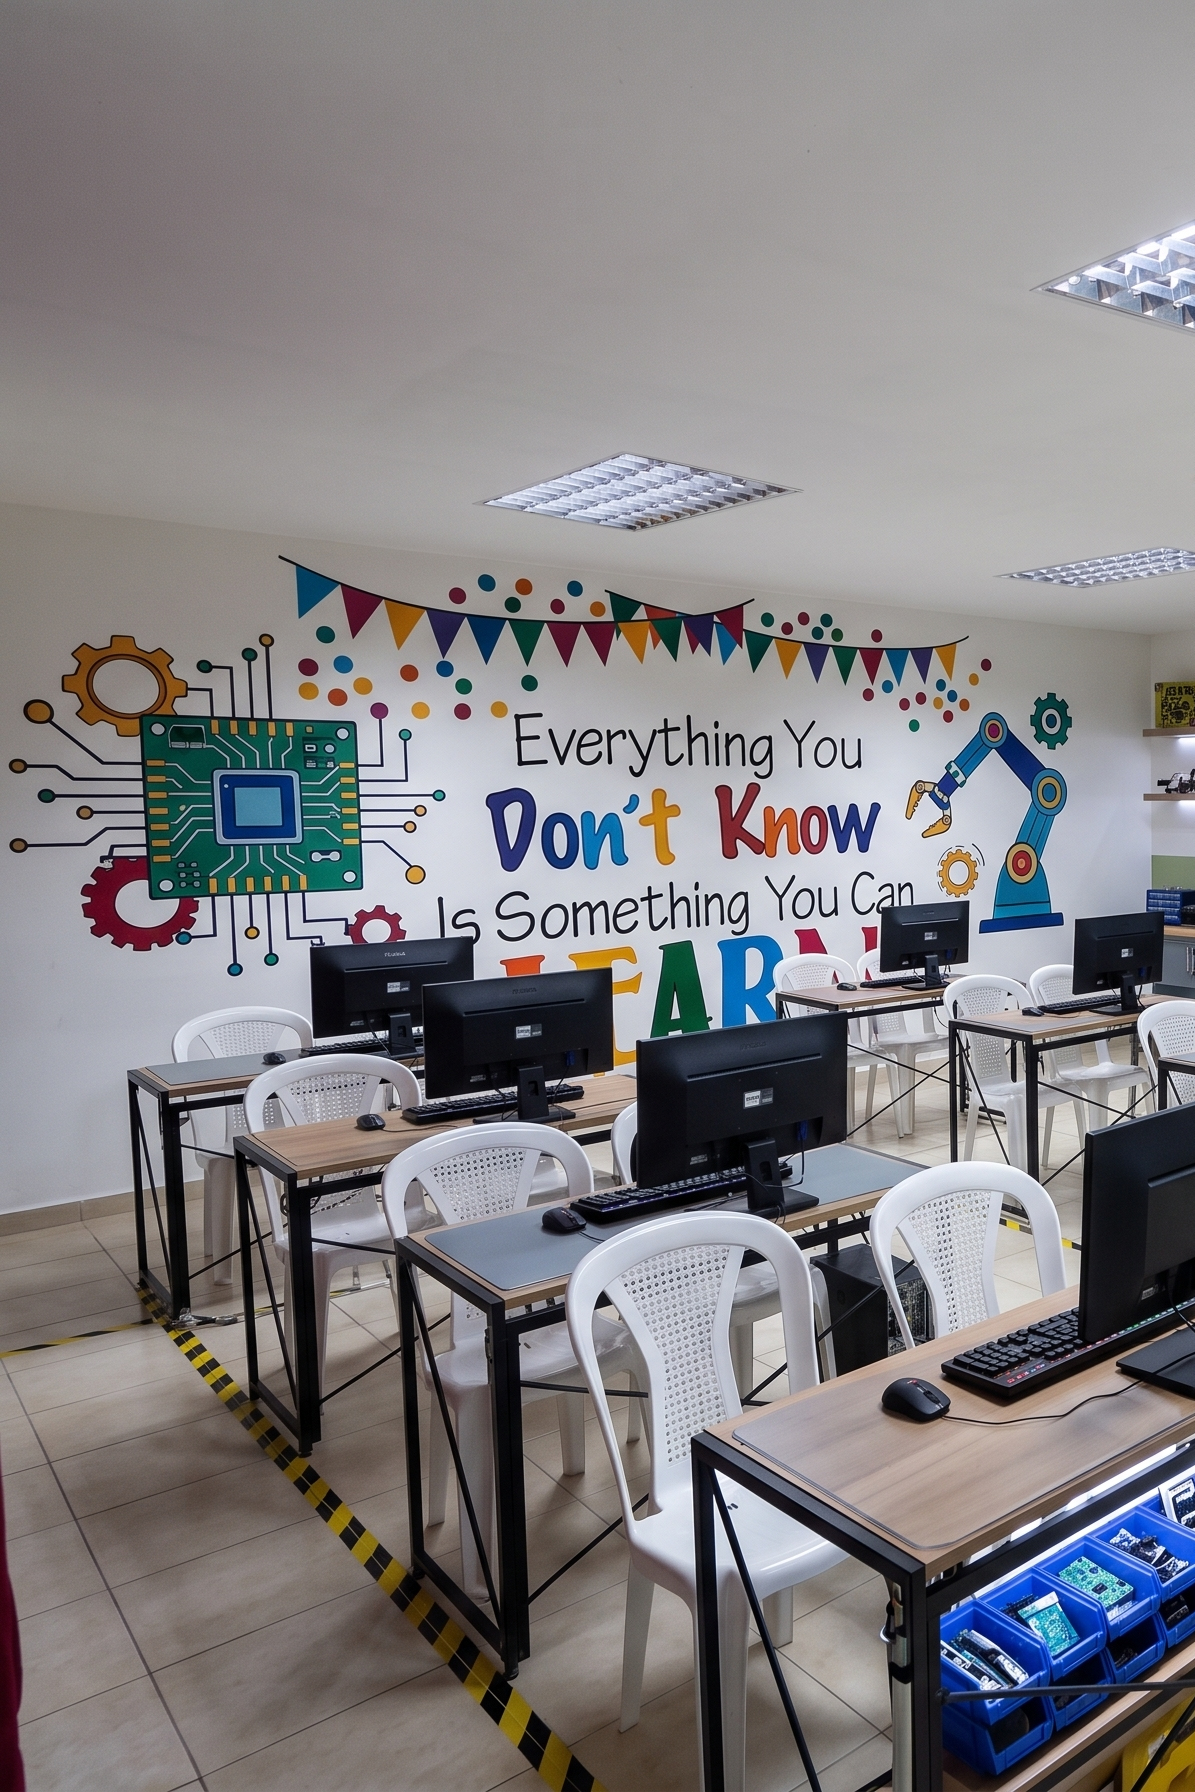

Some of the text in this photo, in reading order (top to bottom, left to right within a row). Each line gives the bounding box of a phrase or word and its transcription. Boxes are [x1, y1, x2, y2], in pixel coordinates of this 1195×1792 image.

[514, 713, 861, 779] Everything You
[486, 782, 881, 872] Don't Know
[438, 871, 914, 944] Is Something You Can
